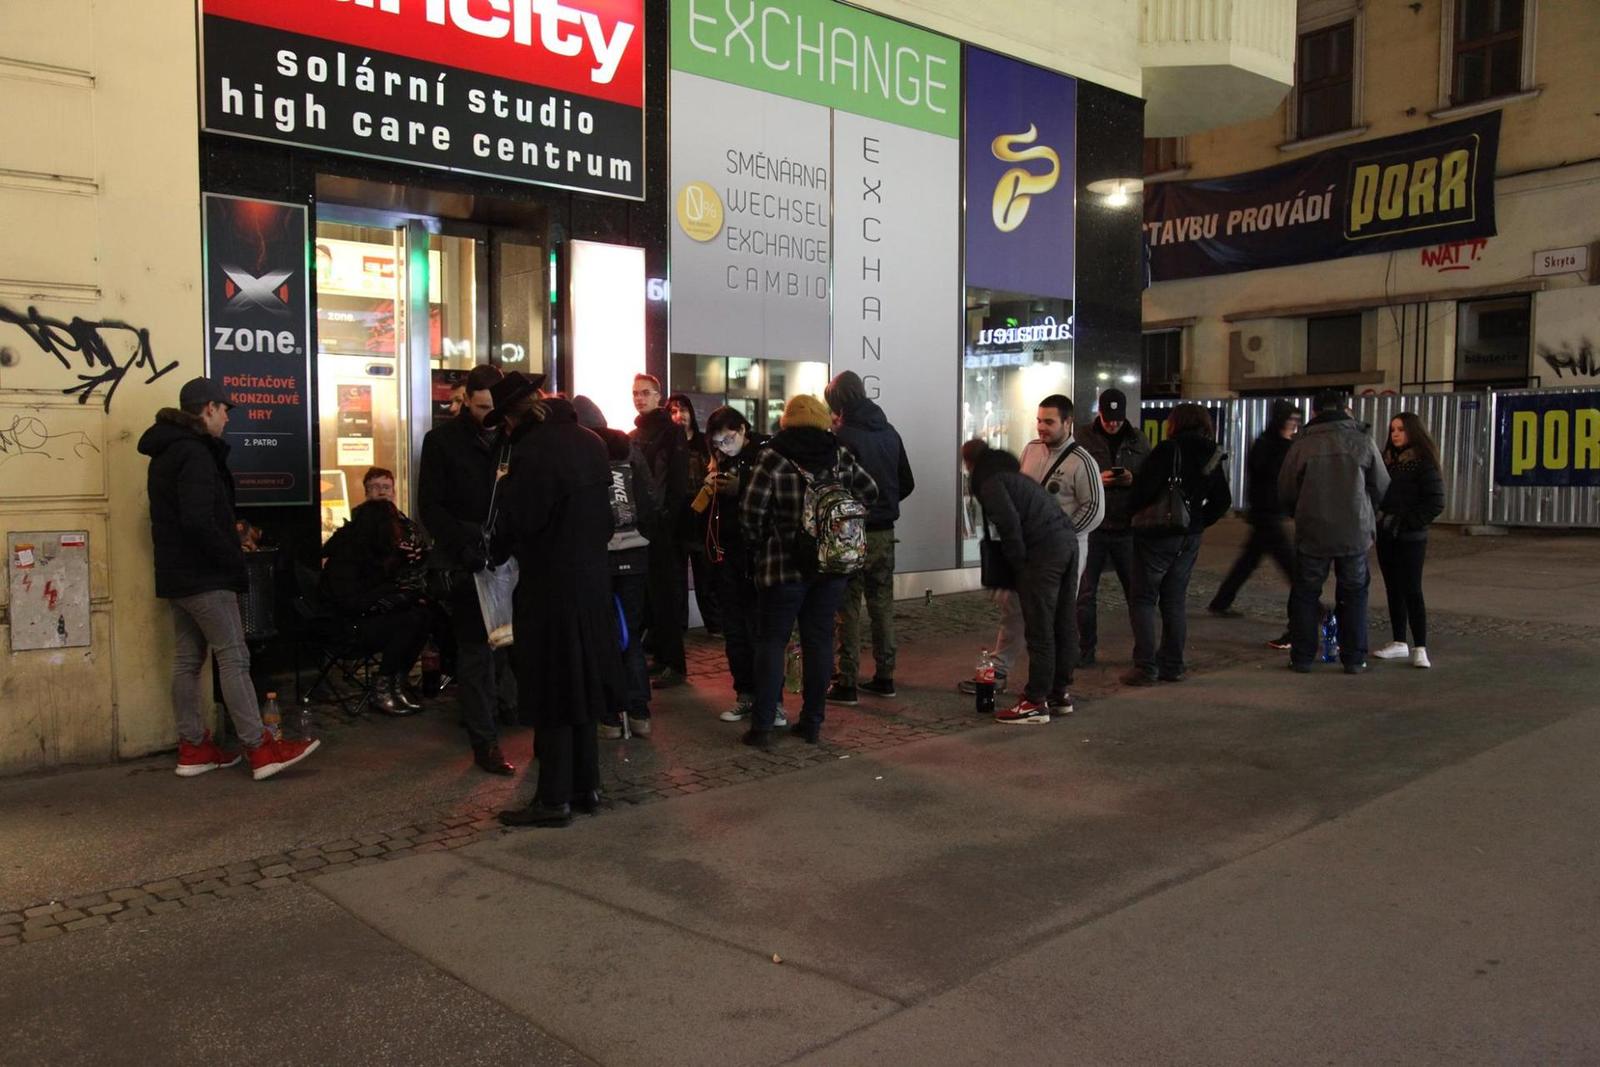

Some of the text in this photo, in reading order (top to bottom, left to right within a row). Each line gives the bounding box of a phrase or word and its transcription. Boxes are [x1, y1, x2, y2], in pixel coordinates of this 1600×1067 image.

[689, 0, 947, 114] EXCHANGE
[276, 48, 594, 135] solární studio
[221, 77, 632, 183] high care centrum
[726, 149, 828, 191] SMĚNÁRNA
[1349, 148, 1470, 233] PORR
[726, 187, 828, 228] WECHSEL
[1143, 184, 1337, 246] TAVBU PROVÁDÍ
[726, 226, 828, 264] EXCHANGE
[726, 265, 828, 300] CAMBIO
[248, 409, 273, 420] HRY
[253, 438, 278, 447] PATRO
[611, 470, 629, 503] NIKE
